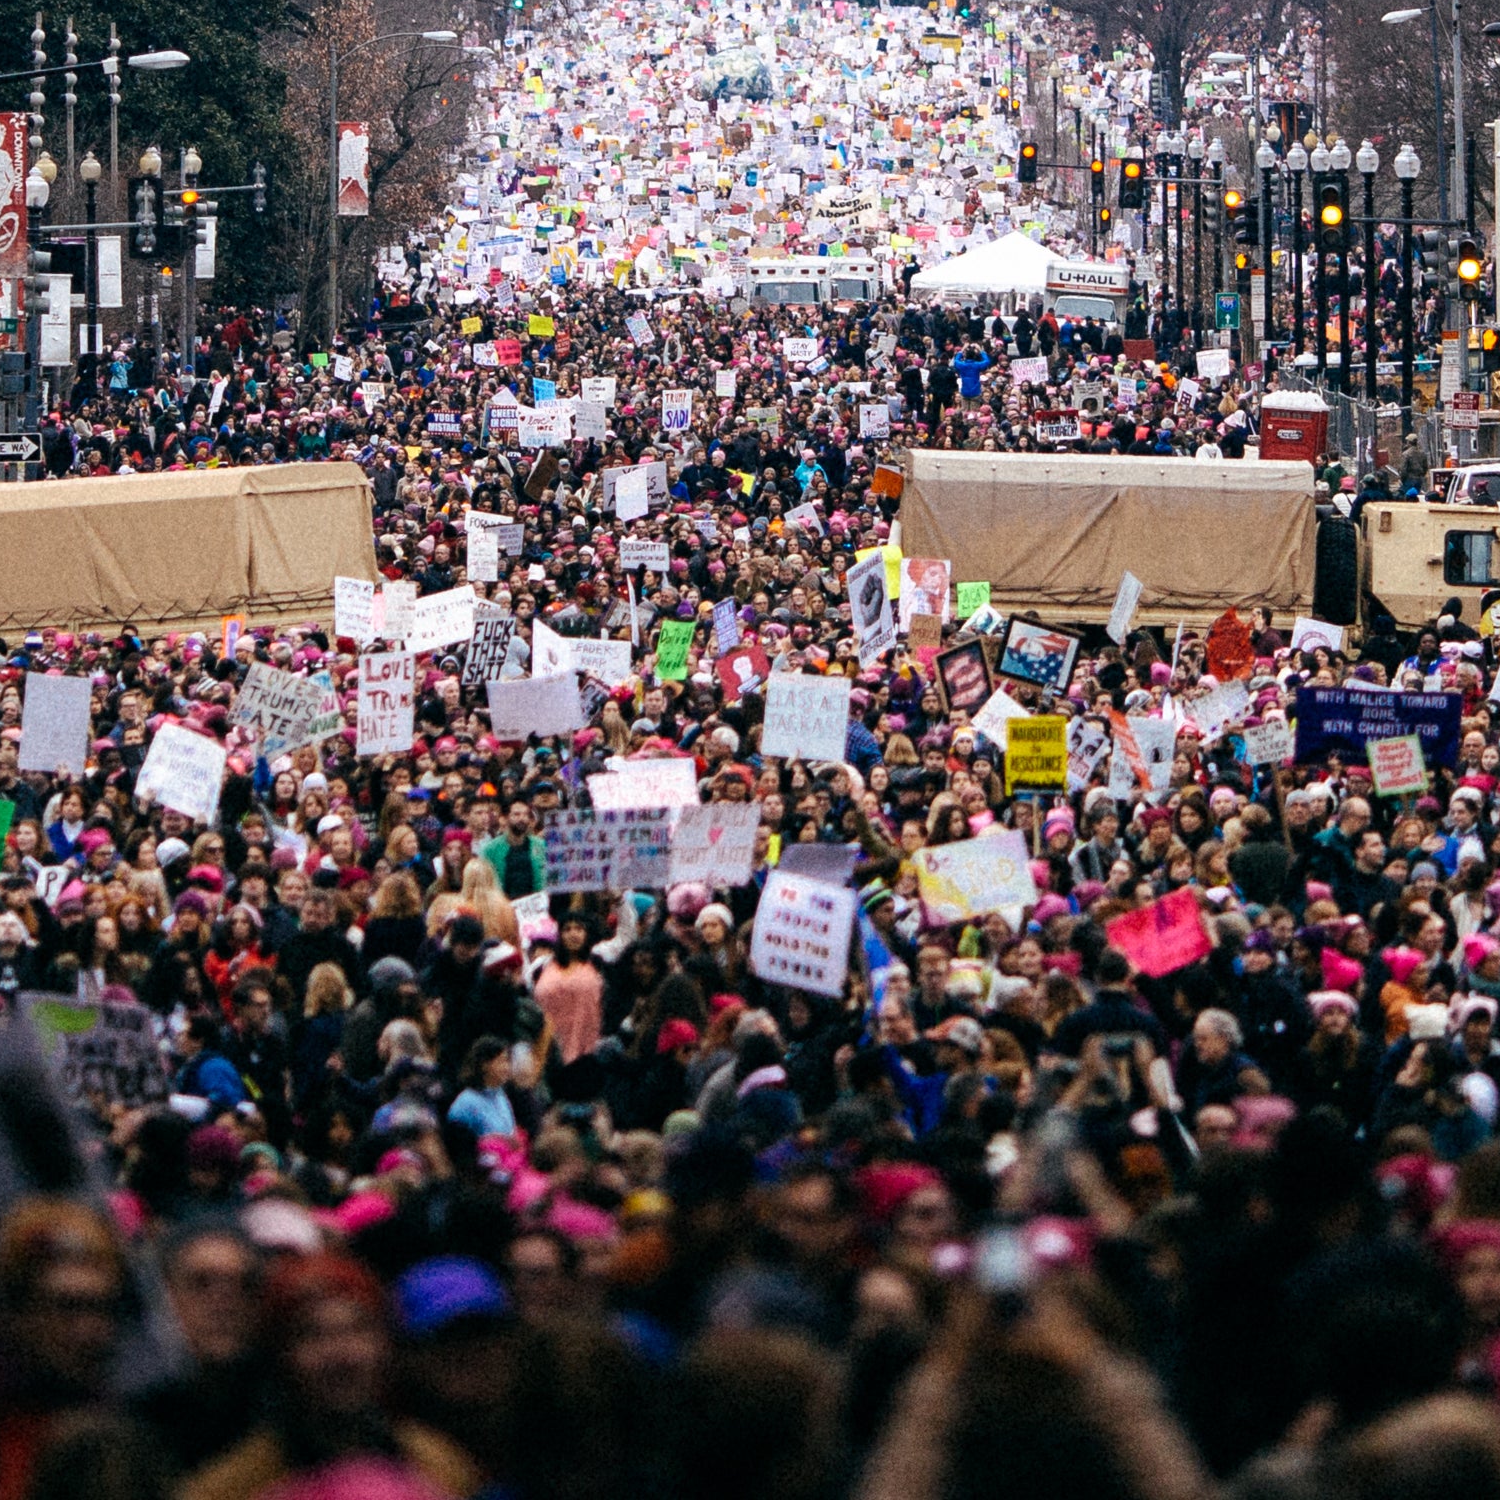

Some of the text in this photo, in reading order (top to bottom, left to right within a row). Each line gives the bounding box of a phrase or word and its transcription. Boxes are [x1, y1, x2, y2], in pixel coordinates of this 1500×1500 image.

[14, 131, 23, 192] DOWNTOWN
[829, 198, 861, 211] Keep
[1058, 272, 1117, 286] U-HAUL
[791, 341, 808, 350] STAY
[665, 392, 686, 402] TRUMP
[427, 422, 461, 432] MISTAKE
[433, 413, 455, 423] YUGE
[491, 418, 518, 427] IN CHIE
[665, 408, 689, 429] SAD!
[12, 443, 31, 453] WAY
[474, 619, 513, 643] FUCK
[471, 640, 508, 664] THIS
[364, 658, 411, 682] LOVE
[465, 661, 504, 684] SHIT
[253, 664, 305, 698] LOVE
[248, 684, 318, 722] TRUMPS
[1315, 691, 1448, 709] WITH MALICE TOWARD
[360, 715, 398, 744] HATE
[1323, 720, 1440, 738] WITH CHARITY FOR
[1010, 756, 1063, 773] RESISTANCE
